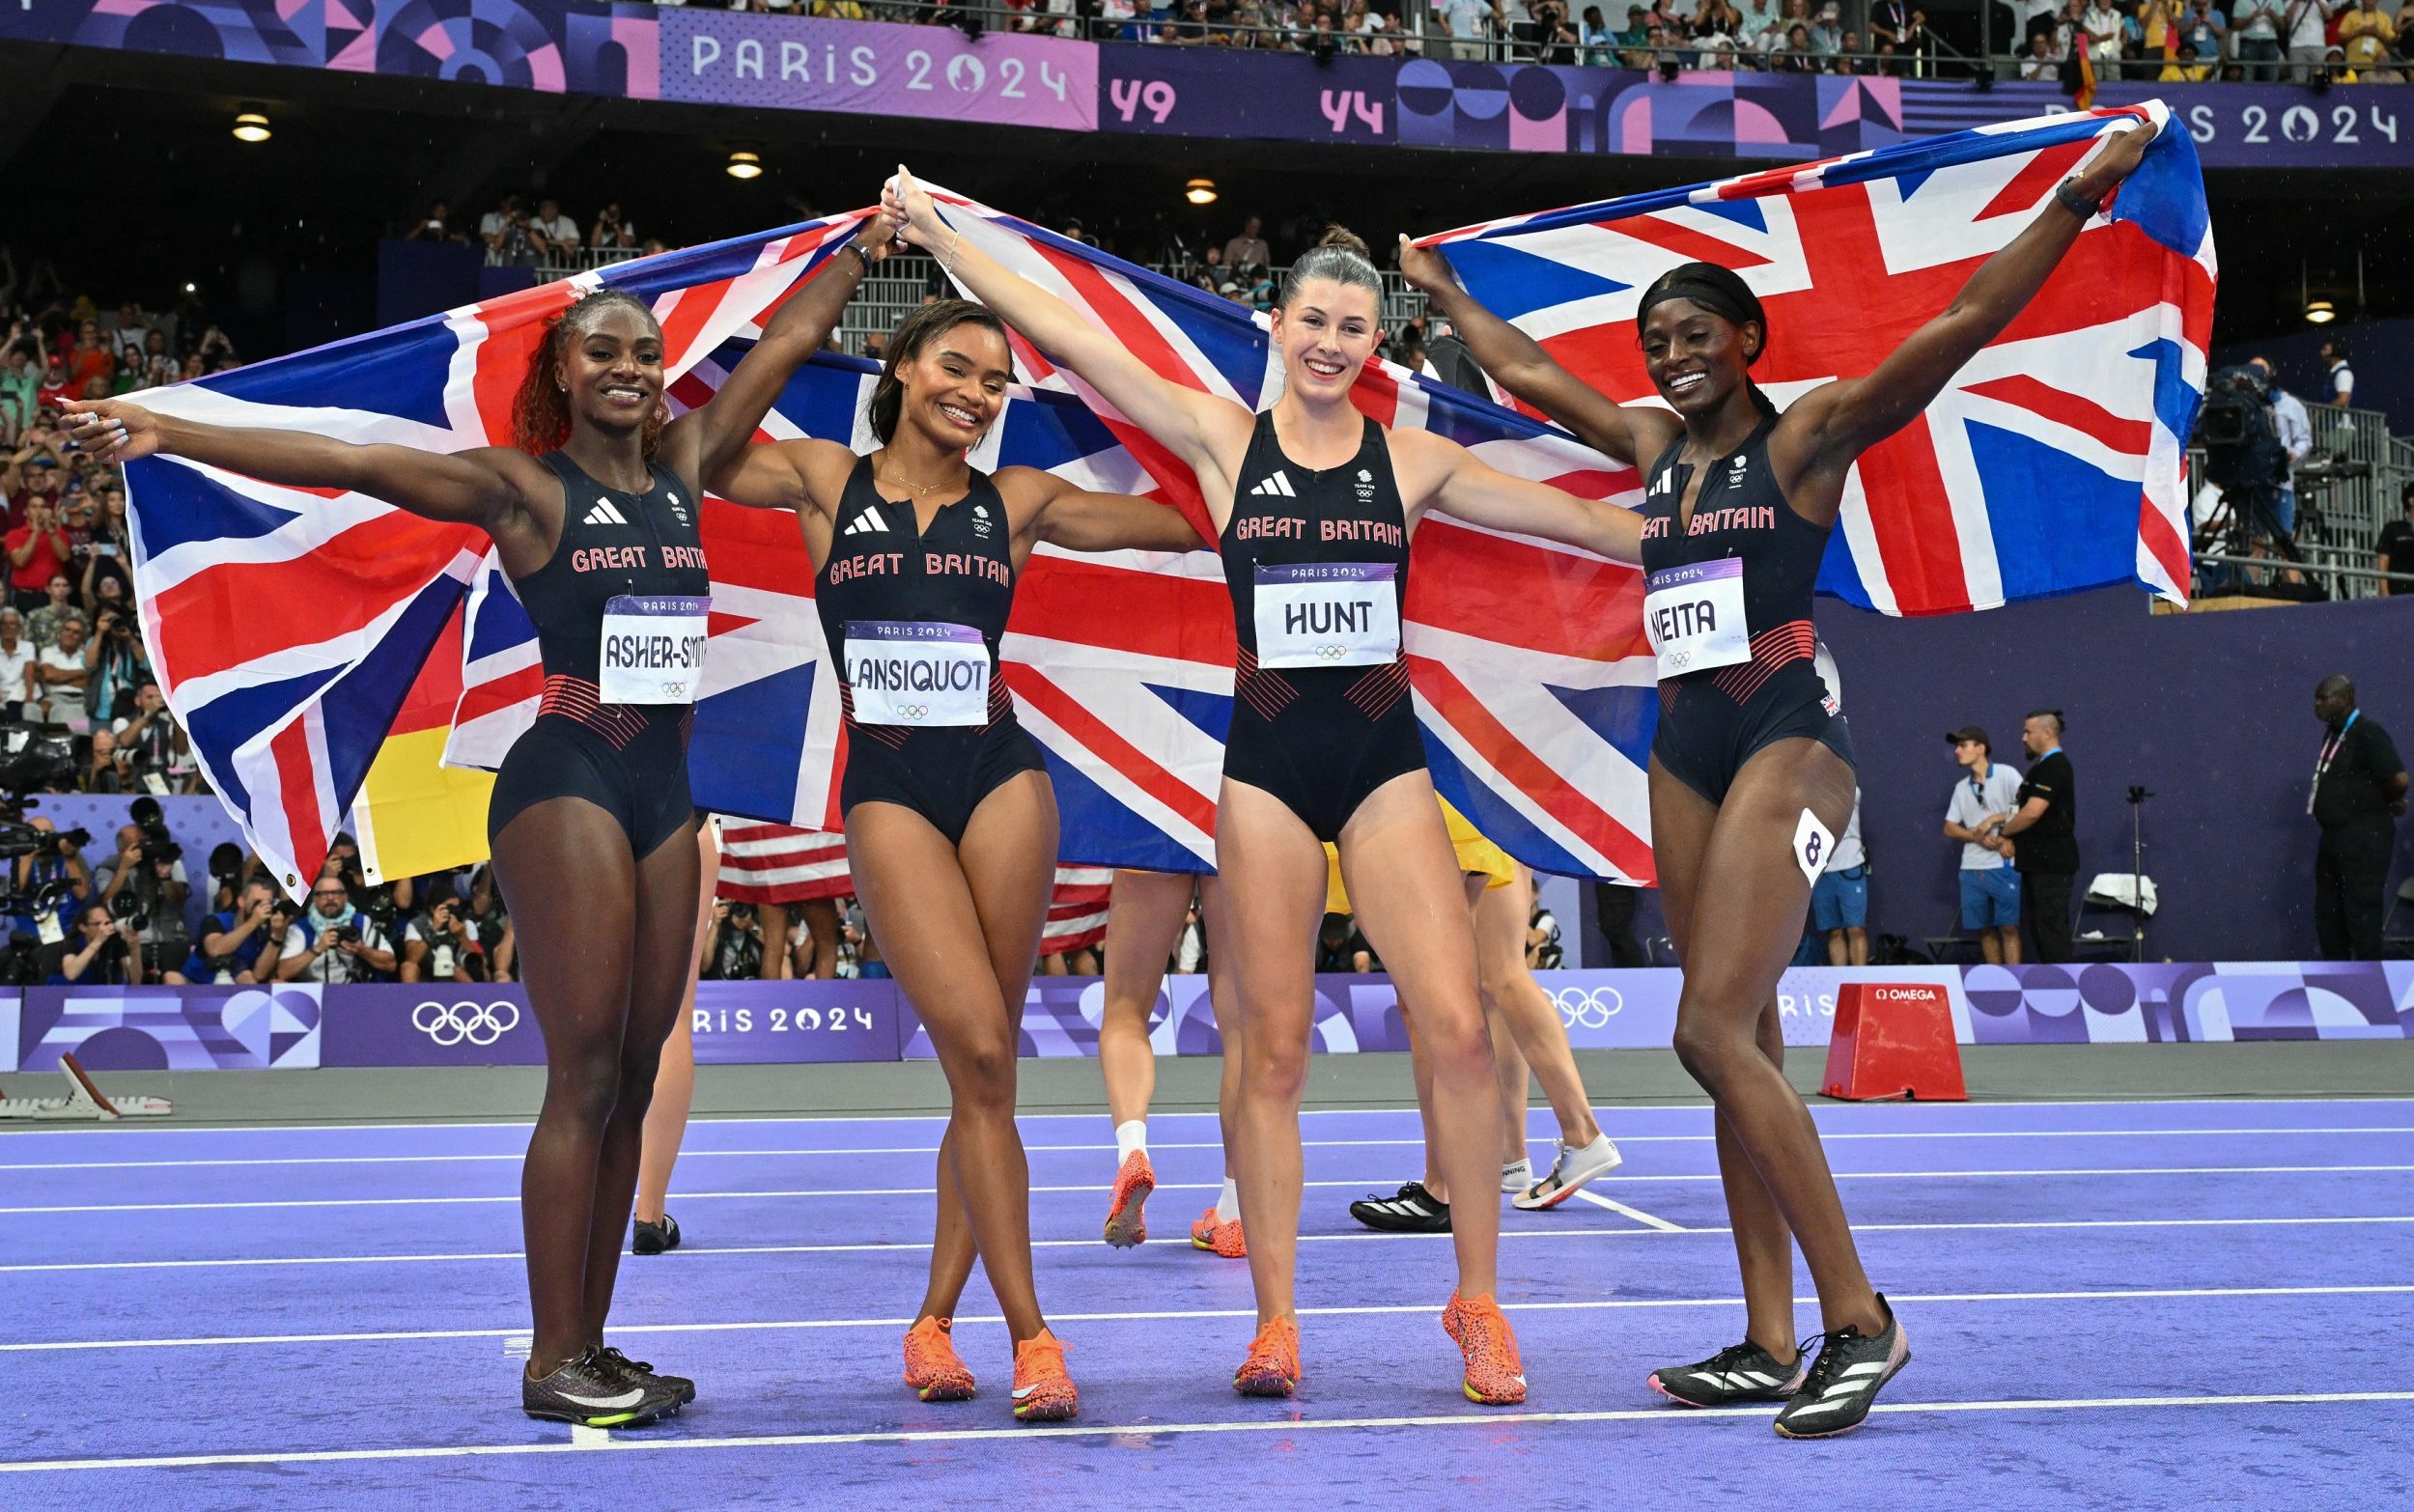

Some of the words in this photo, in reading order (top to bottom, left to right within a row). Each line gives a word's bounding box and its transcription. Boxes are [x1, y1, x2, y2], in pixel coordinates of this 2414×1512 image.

[906, 49, 1067, 102] 2024
[1110, 79, 1176, 124] 49
[1321, 90, 1384, 134] 44
[2242, 104, 2398, 144] 2024
[1237, 516, 1306, 541] GREAT
[1321, 519, 1402, 548] BRITAIN
[1641, 517, 1671, 540] EAT
[1688, 507, 1776, 537] BRITAIN
[572, 546, 646, 573] GREAT
[661, 546, 708, 570] BRITA
[830, 553, 904, 585] GREAT
[925, 553, 1010, 588] BRITAIN
[1333, 568, 1365, 577] 2024
[1674, 568, 1703, 582] 2024
[917, 628, 951, 637] 2024
[1285, 601, 1373, 635] HUNT
[1650, 600, 1716, 645] NEITA
[605, 634, 708, 669] ASHER-SMIT
[847, 658, 987, 692] LANSIQUOT
[1805, 830, 1822, 867] 8
[1889, 989, 1936, 1001] OMEGA
[770, 1007, 873, 1032] 2024
[1502, 1165, 1526, 1177] NNING
